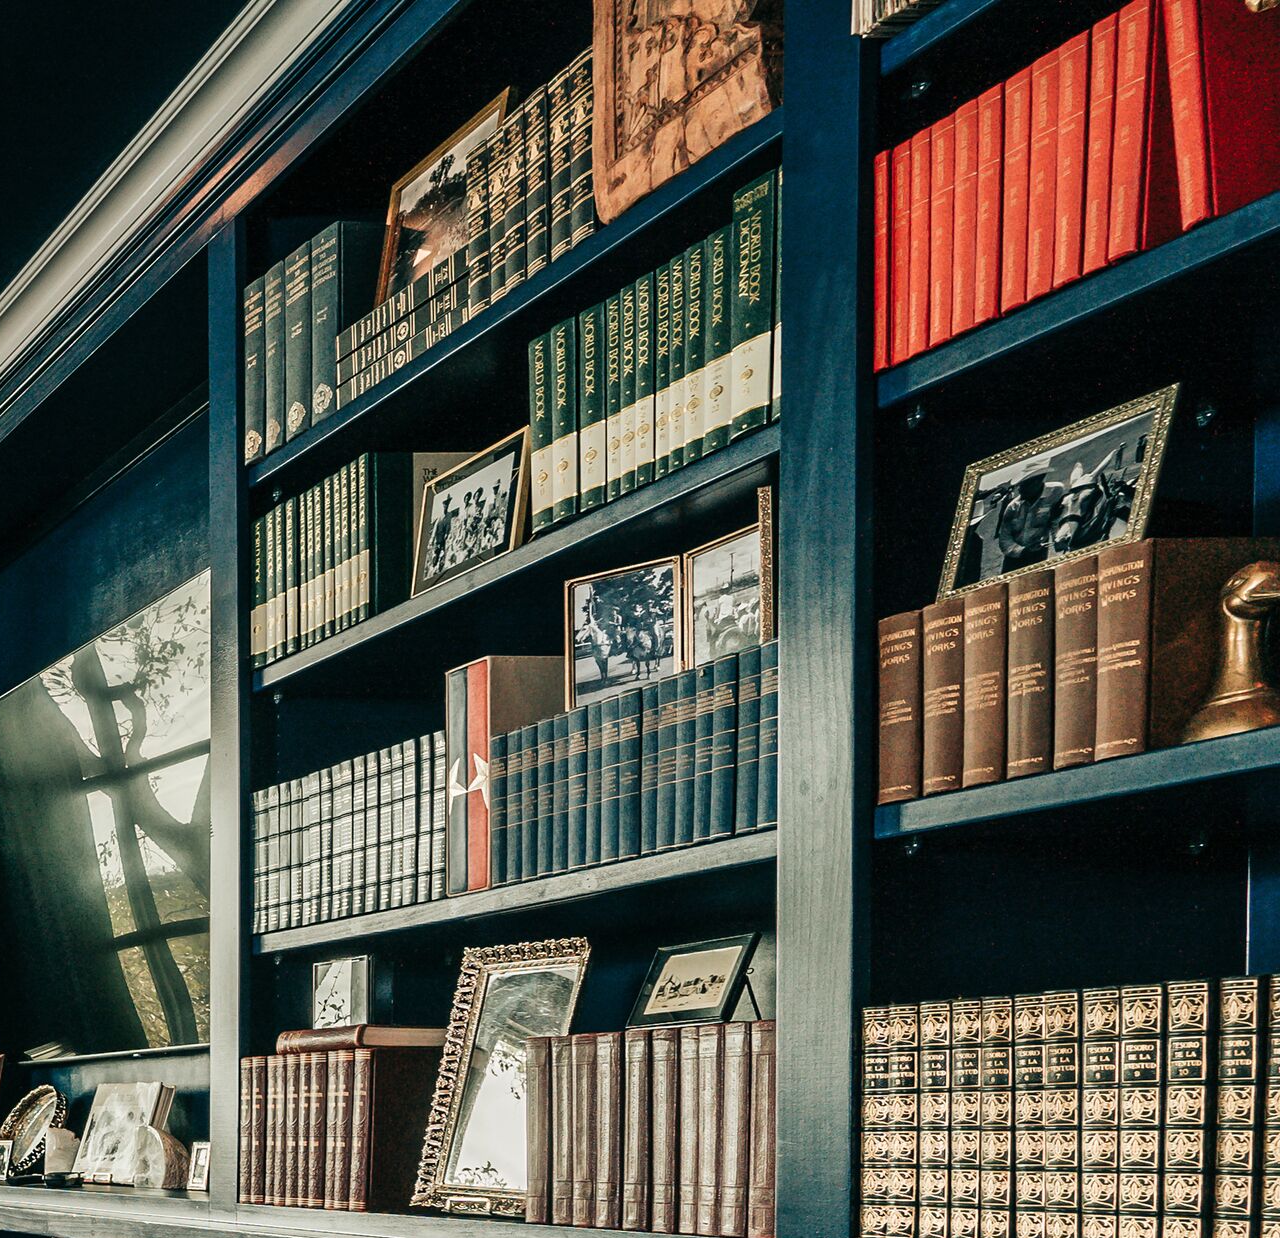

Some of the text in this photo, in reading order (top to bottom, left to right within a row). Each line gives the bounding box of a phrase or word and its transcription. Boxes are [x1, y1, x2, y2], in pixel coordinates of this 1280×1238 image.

[689, 249, 701, 339] WORLD BOOK
[712, 234, 724, 326] WORLD BOOK
[738, 218, 750, 298] DICTIONARY
[749, 210, 762, 304] WORLD BOOK
[609, 300, 618, 386] WORLD BOOK
[623, 290, 633, 377] WORLD BOOK
[639, 281, 649, 368] WORLD BOOK
[658, 271, 669, 359] WORLD BOOK
[672, 259, 683, 349] WORLD BOOK
[535, 341, 544, 422] WORLD BOOK
[556, 327, 566, 409] WORLD BOOK
[584, 313, 595, 397] WORLD BOOK
[423, 468, 438, 476] THE
